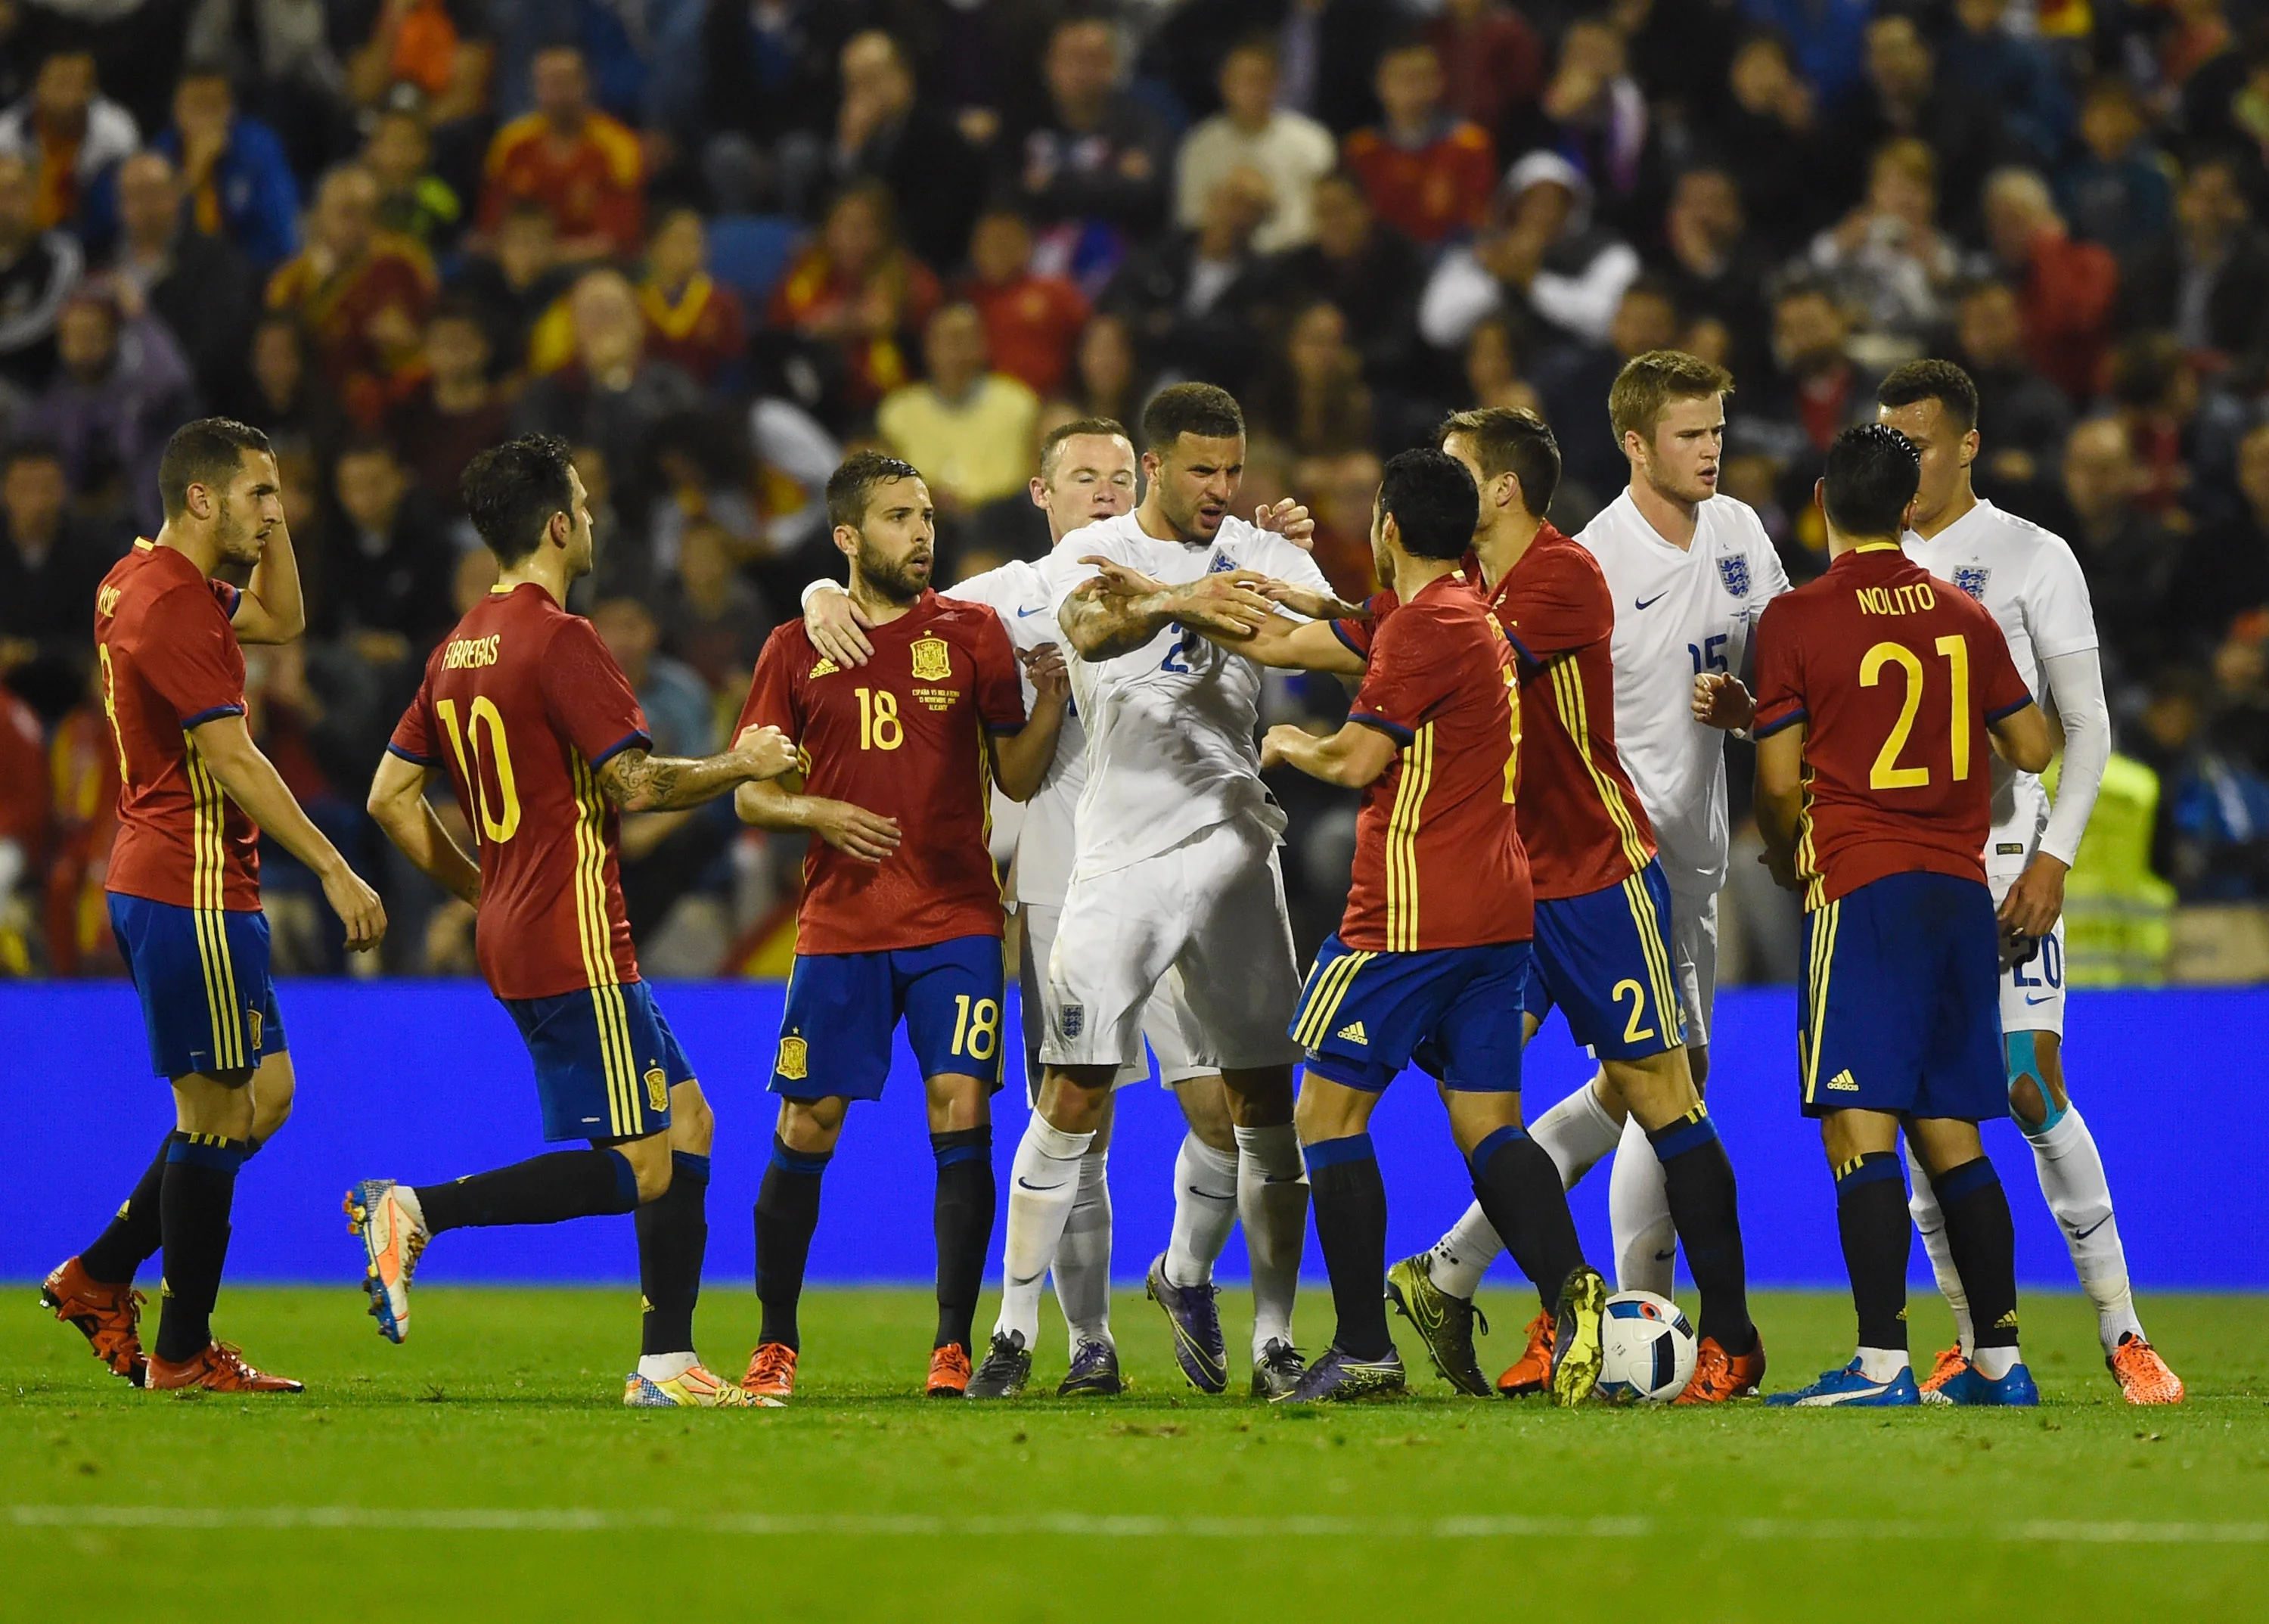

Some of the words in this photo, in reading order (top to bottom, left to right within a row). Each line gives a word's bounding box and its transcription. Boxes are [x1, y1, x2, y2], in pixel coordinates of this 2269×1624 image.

[1855, 582, 1935, 615] NOLITO
[809, 666, 840, 679] adidas
[1160, 623, 1197, 674] 2
[854, 687, 904, 750] 18
[1859, 634, 1969, 790] 21
[436, 694, 521, 846] 10
[2012, 932, 2061, 989] 20
[951, 994, 998, 1060] 18
[1337, 1030, 1368, 1046] adidas
[1612, 978, 1654, 1044] 2
[1827, 1082, 1860, 1091] adidas
